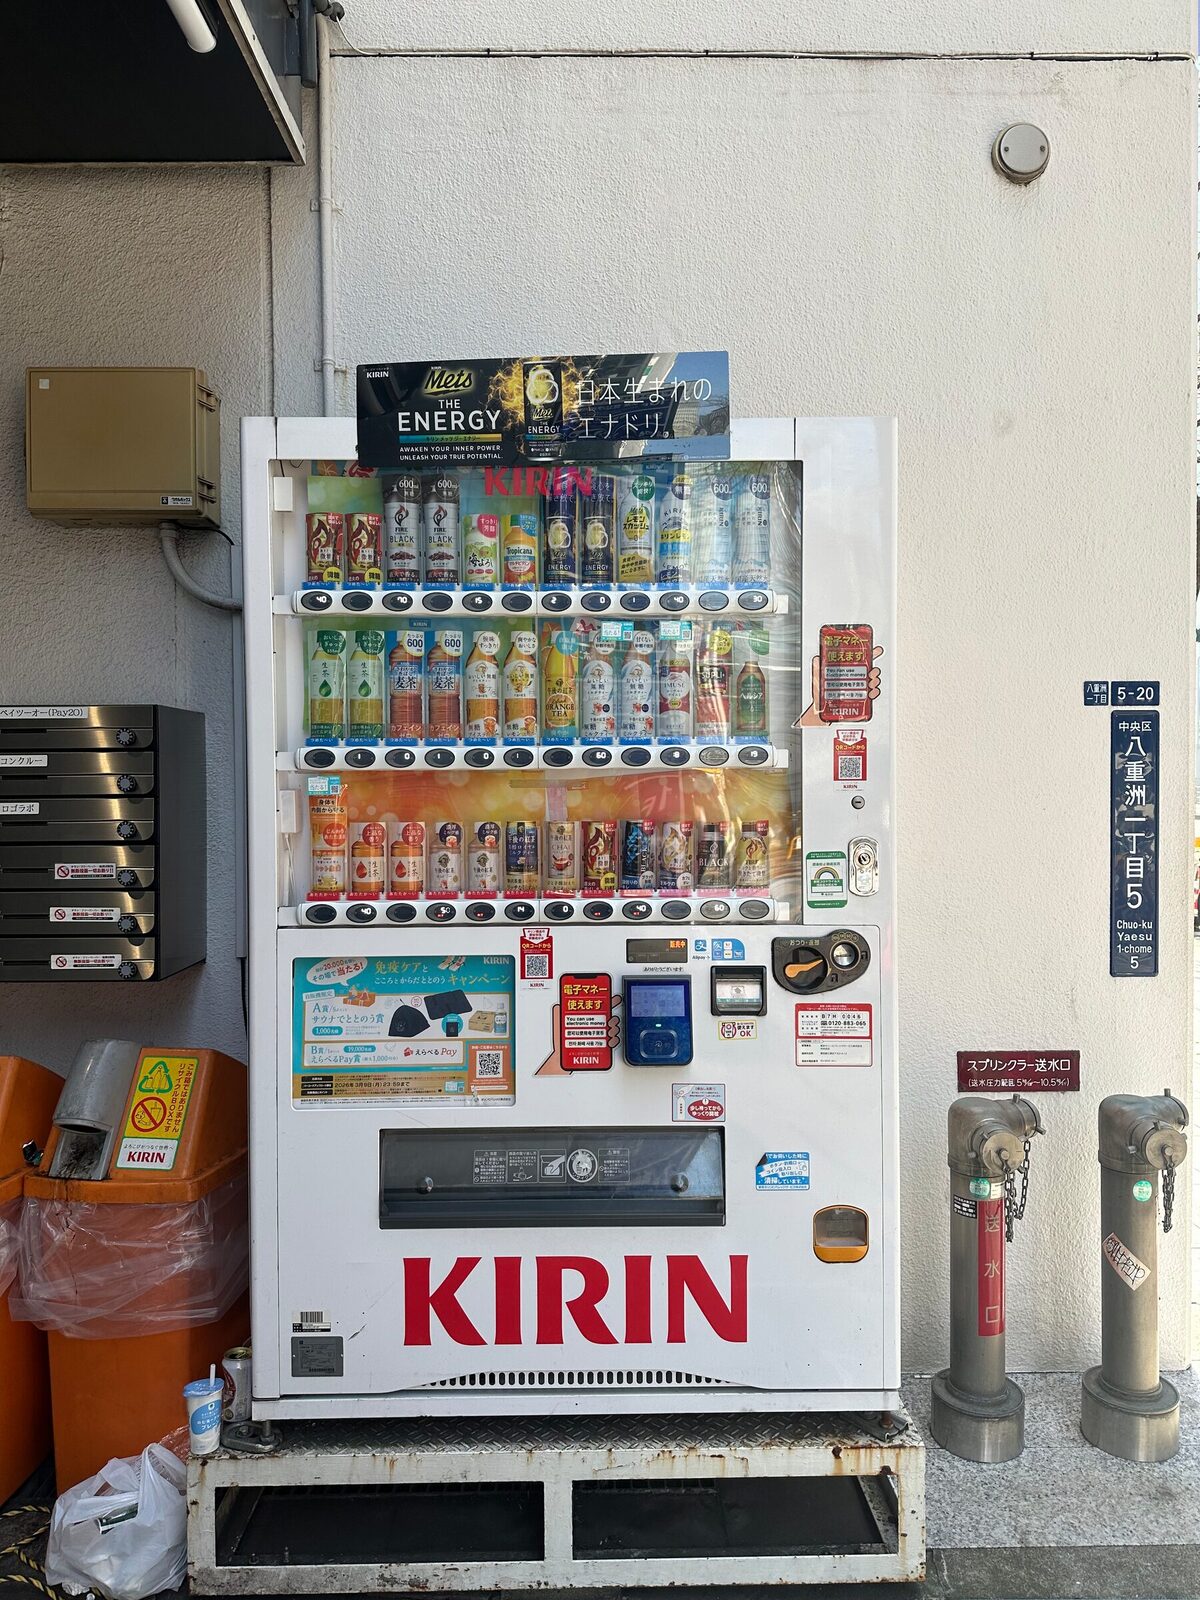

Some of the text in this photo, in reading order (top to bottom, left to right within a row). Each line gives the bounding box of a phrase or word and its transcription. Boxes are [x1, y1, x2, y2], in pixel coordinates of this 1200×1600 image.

[424, 369, 473, 390] Mets
[578, 377, 712, 406] 日本生まれの
[438, 399, 460, 408] THE
[398, 410, 501, 432] ENERGY
[528, 425, 560, 434] ENERGY
[484, 466, 592, 497] KIRIN
[506, 547, 532, 555] Tropicana
[407, 639, 423, 647] 600
[444, 639, 461, 647] 600
[827, 651, 864, 662] 使えます
[396, 676, 416, 689] 麦茶
[434, 676, 454, 689] 麦茶
[1087, 684, 1107, 693] 八重洲
[1118, 687, 1154, 700] 5-20
[1087, 694, 1106, 703] 一丁目
[1119, 721, 1152, 732] 中央区
[1116, 920, 1152, 929] Chuo-ku
[1117, 932, 1152, 941] Yaesu
[1117, 944, 1152, 953] 1-chome
[376, 960, 429, 974] 免疫ケアと
[1131, 956, 1139, 969] 5
[564, 985, 608, 995] 電子マネー
[568, 1000, 602, 1010] 使えます
[312, 1014, 384, 1023] サウナでととのう賞
[573, 1056, 599, 1064] KIRIN
[967, 1058, 1070, 1072] スプリンクラー送水口
[164, 1064, 185, 1132] リサイクルBOXです
[172, 1064, 194, 1133] ごみ箱ではありません
[127, 1151, 166, 1163] KIRIN
[984, 1212, 1000, 1323] 送水口
[403, 1255, 748, 1346] KIRIN
